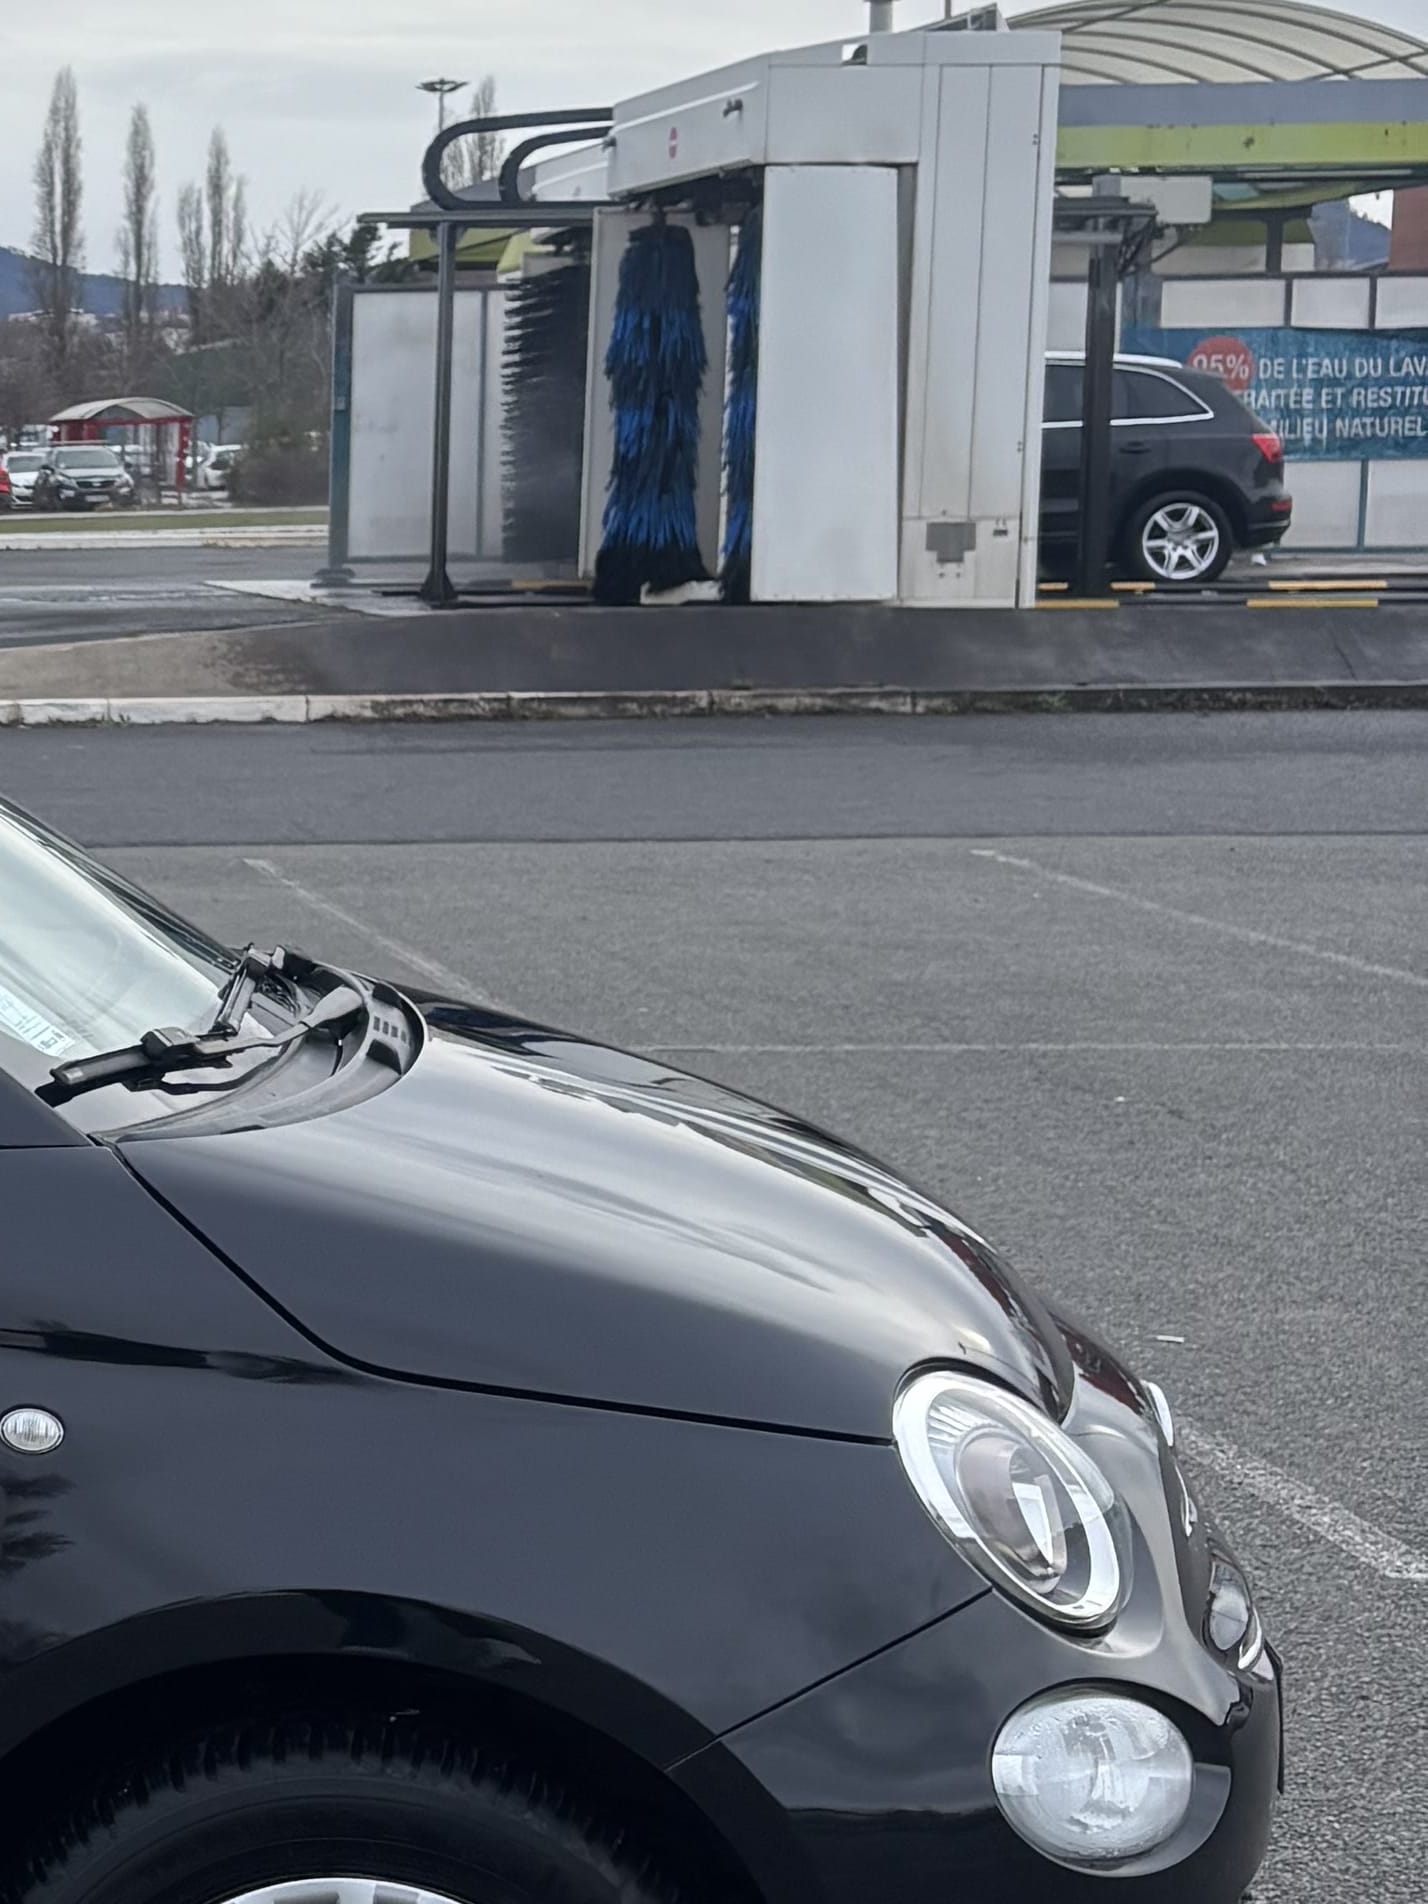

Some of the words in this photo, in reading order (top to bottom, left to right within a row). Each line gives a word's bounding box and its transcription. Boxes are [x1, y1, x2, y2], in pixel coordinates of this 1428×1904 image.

[1259, 357, 1287, 379] DE
[1291, 357, 1347, 379] L'EAU
[1355, 356, 1382, 378] DU
[1390, 355, 1428, 377] LAV
[1232, 383, 1313, 409] RAITÉE
[1321, 387, 1344, 409] ET
[1335, 416, 1428, 438] NATUREL
